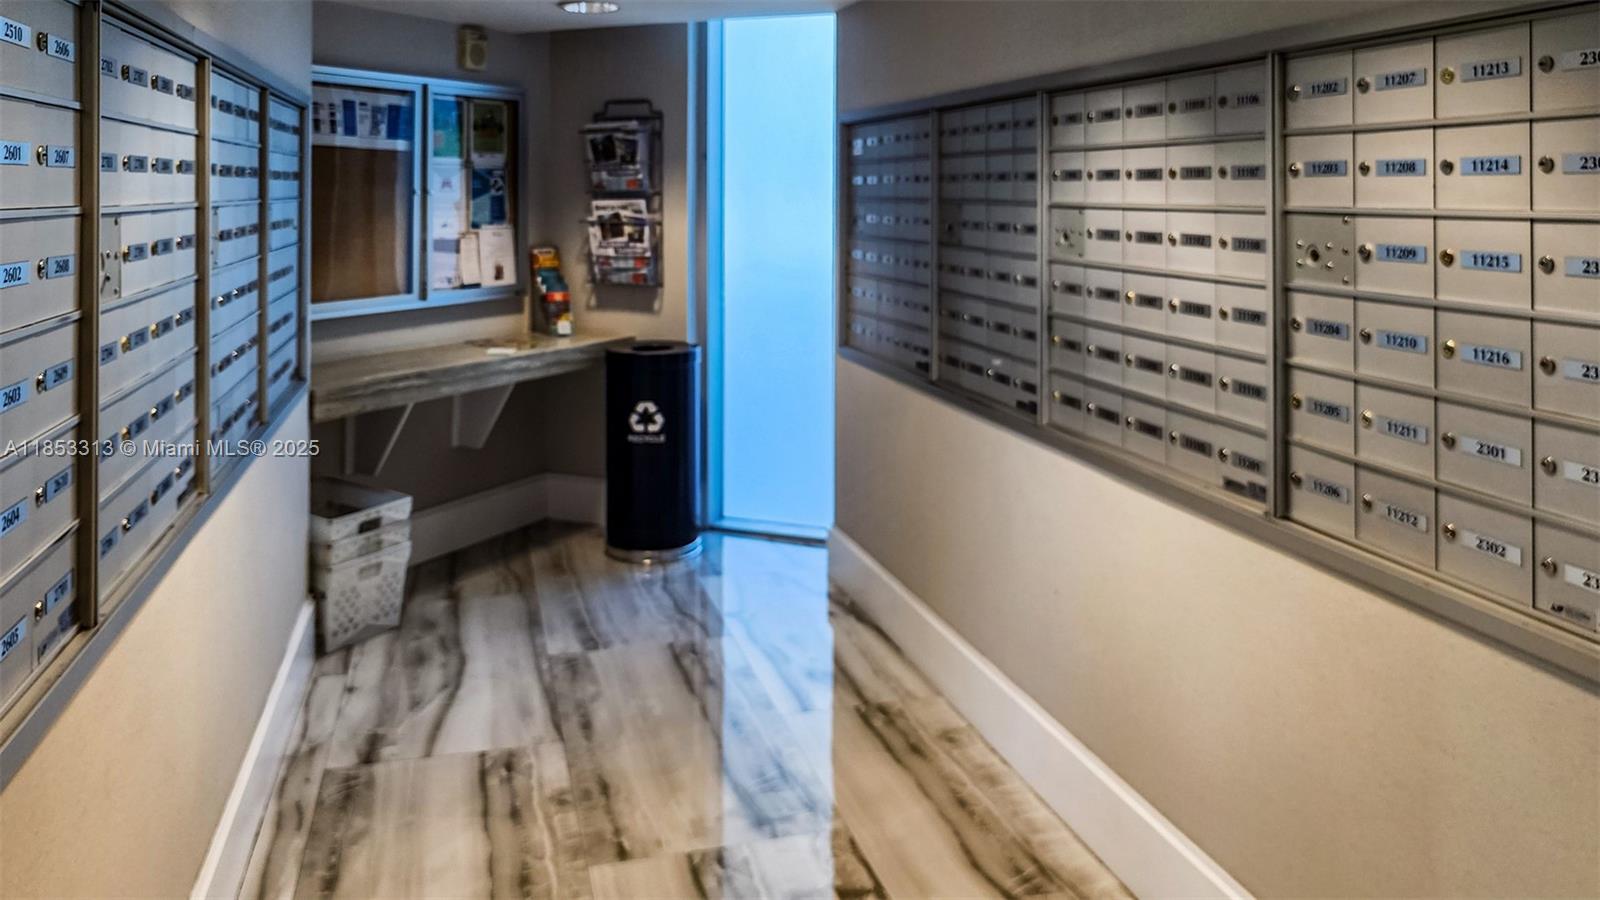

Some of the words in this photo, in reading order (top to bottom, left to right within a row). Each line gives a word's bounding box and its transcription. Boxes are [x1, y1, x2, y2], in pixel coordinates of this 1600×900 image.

[5, 22, 23, 41] 2510
[1472, 62, 1509, 77] 11213
[1385, 72, 1417, 87] 11207
[1311, 82, 1338, 94] 11202
[4, 145, 21, 160] 2601
[55, 150, 70, 164] 2607
[1385, 162, 1417, 174] 11208
[1472, 159, 1509, 172] 11214
[1385, 246, 1417, 260] 11209
[1472, 254, 1509, 268] 11215
[3, 266, 21, 283] 2602
[1385, 334, 1417, 350] 11210
[1472, 347, 1510, 365] 11216
[3, 386, 21, 408] 2603
[1387, 421, 1417, 439] 11211
[1476, 440, 1505, 460] 2301
[2, 507, 20, 533] 2604
[1387, 505, 1418, 528] 11212
[1476, 536, 1506, 558] 2302
[1, 627, 19, 657] 2605
